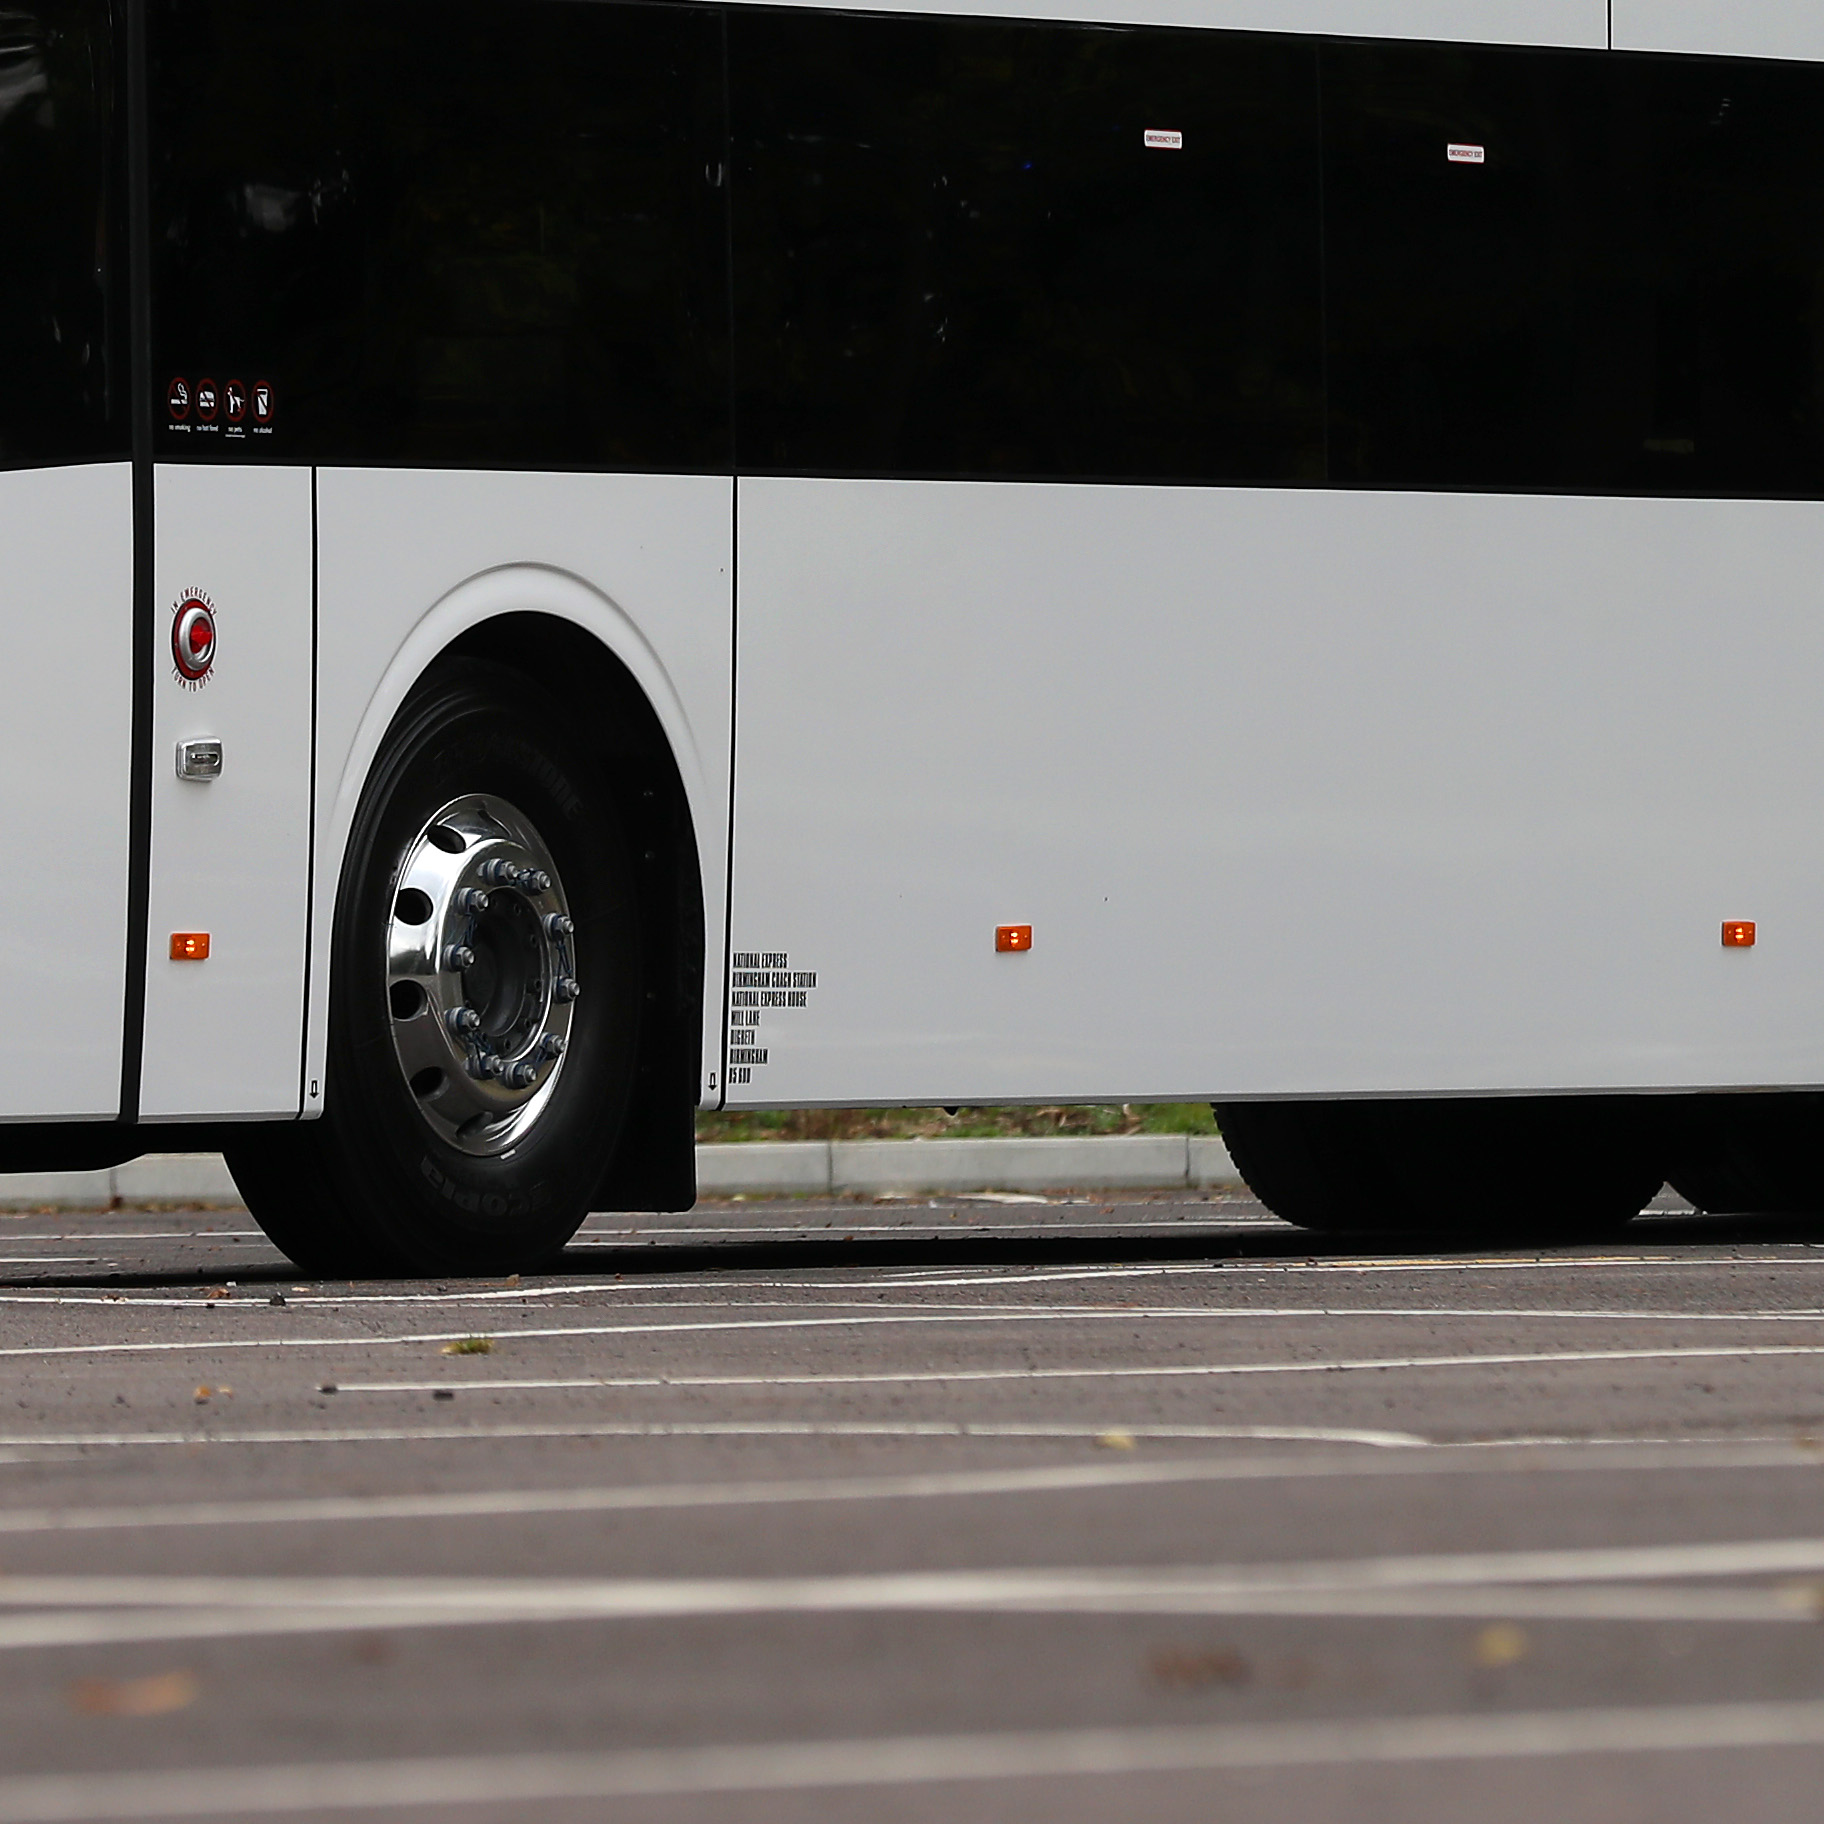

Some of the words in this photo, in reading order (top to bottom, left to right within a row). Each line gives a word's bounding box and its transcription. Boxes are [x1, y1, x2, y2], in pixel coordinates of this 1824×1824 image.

[180, 585, 217, 616] EMERGENCY
[733, 952, 760, 969] NATIONAL
[761, 952, 788, 969] EXPRESS
[731, 991, 759, 1007] NATIONAL
[760, 991, 787, 1007] EXPRESS
